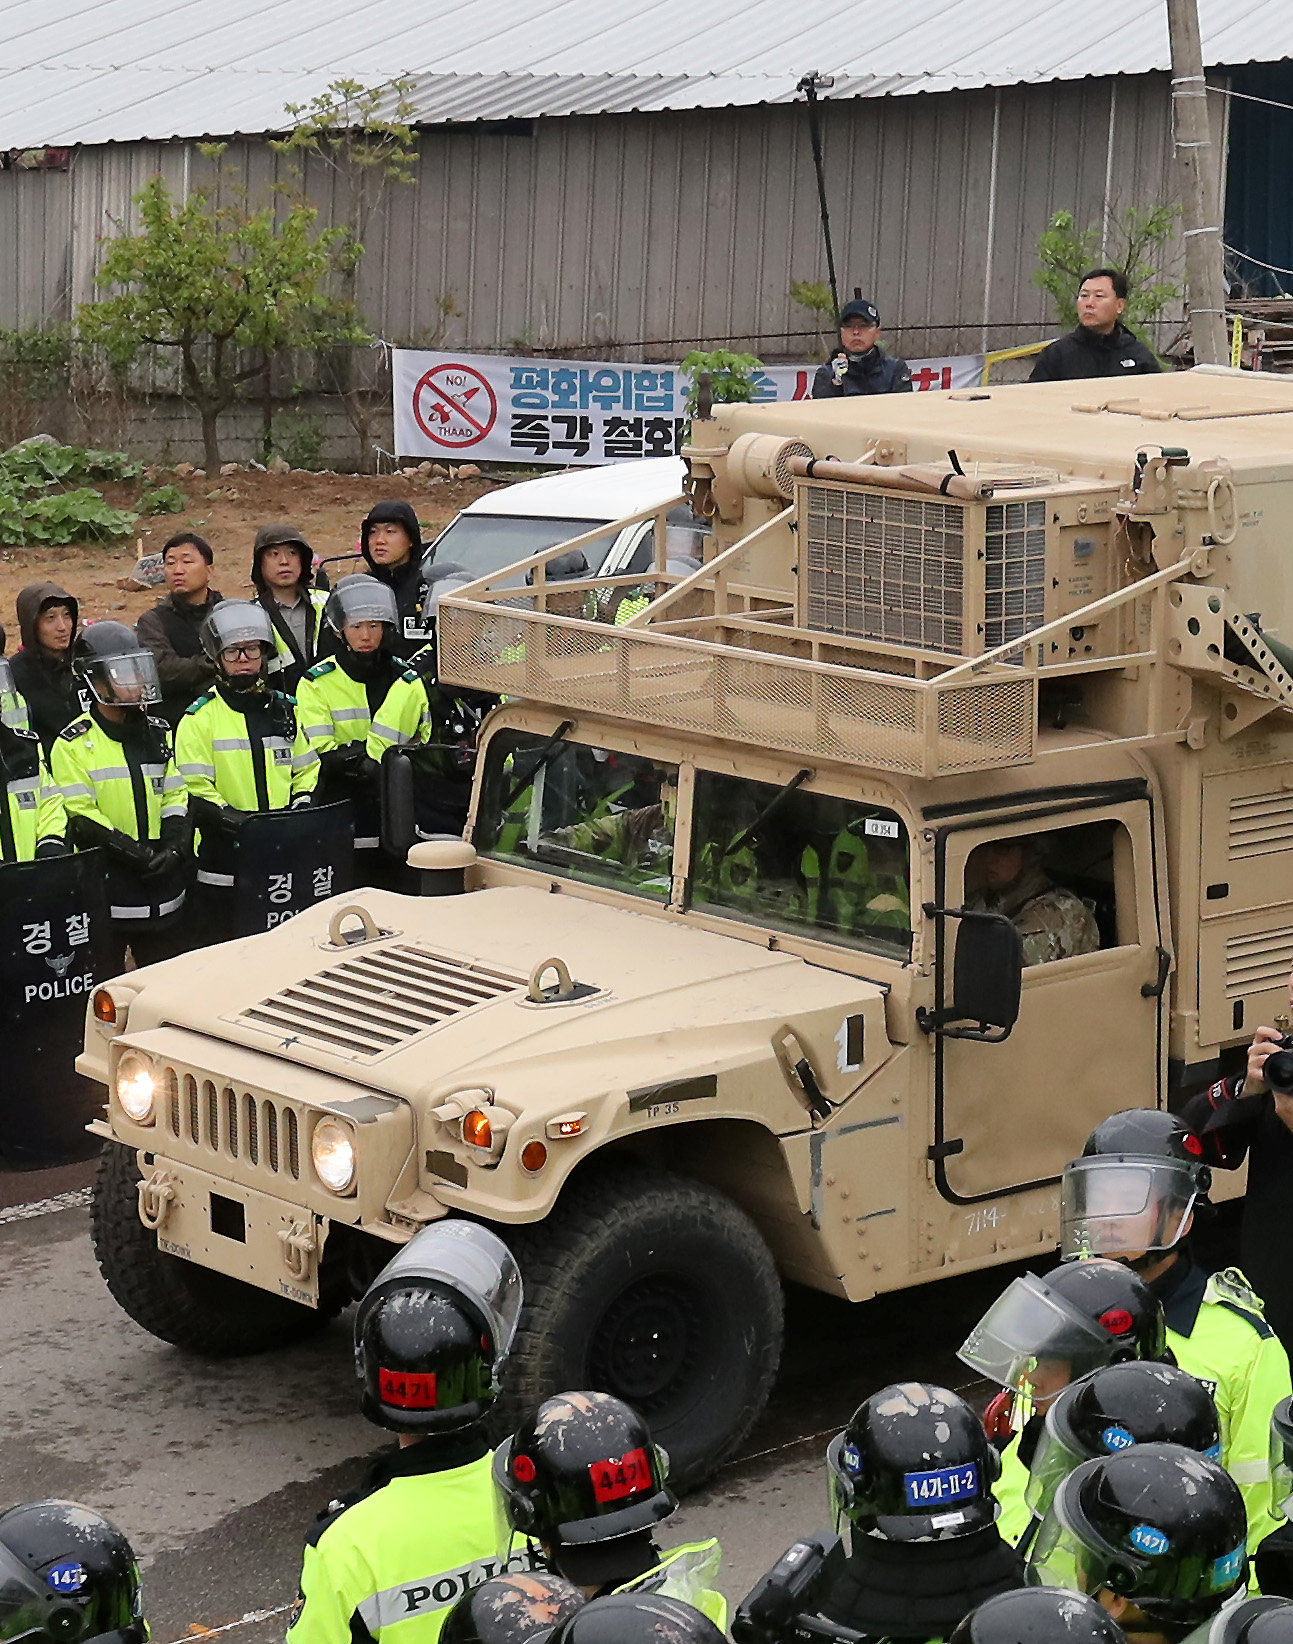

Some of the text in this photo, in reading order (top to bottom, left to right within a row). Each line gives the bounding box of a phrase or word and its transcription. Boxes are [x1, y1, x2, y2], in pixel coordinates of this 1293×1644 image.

[446, 375, 467, 387] NO!
[437, 426, 474, 438] THAAD
[510, 413, 593, 457] 즉각
[24, 972, 95, 1004] POLICE
[646, 1102, 680, 1118] TP 35
[279, 1281, 315, 1304] TIE-DOWN
